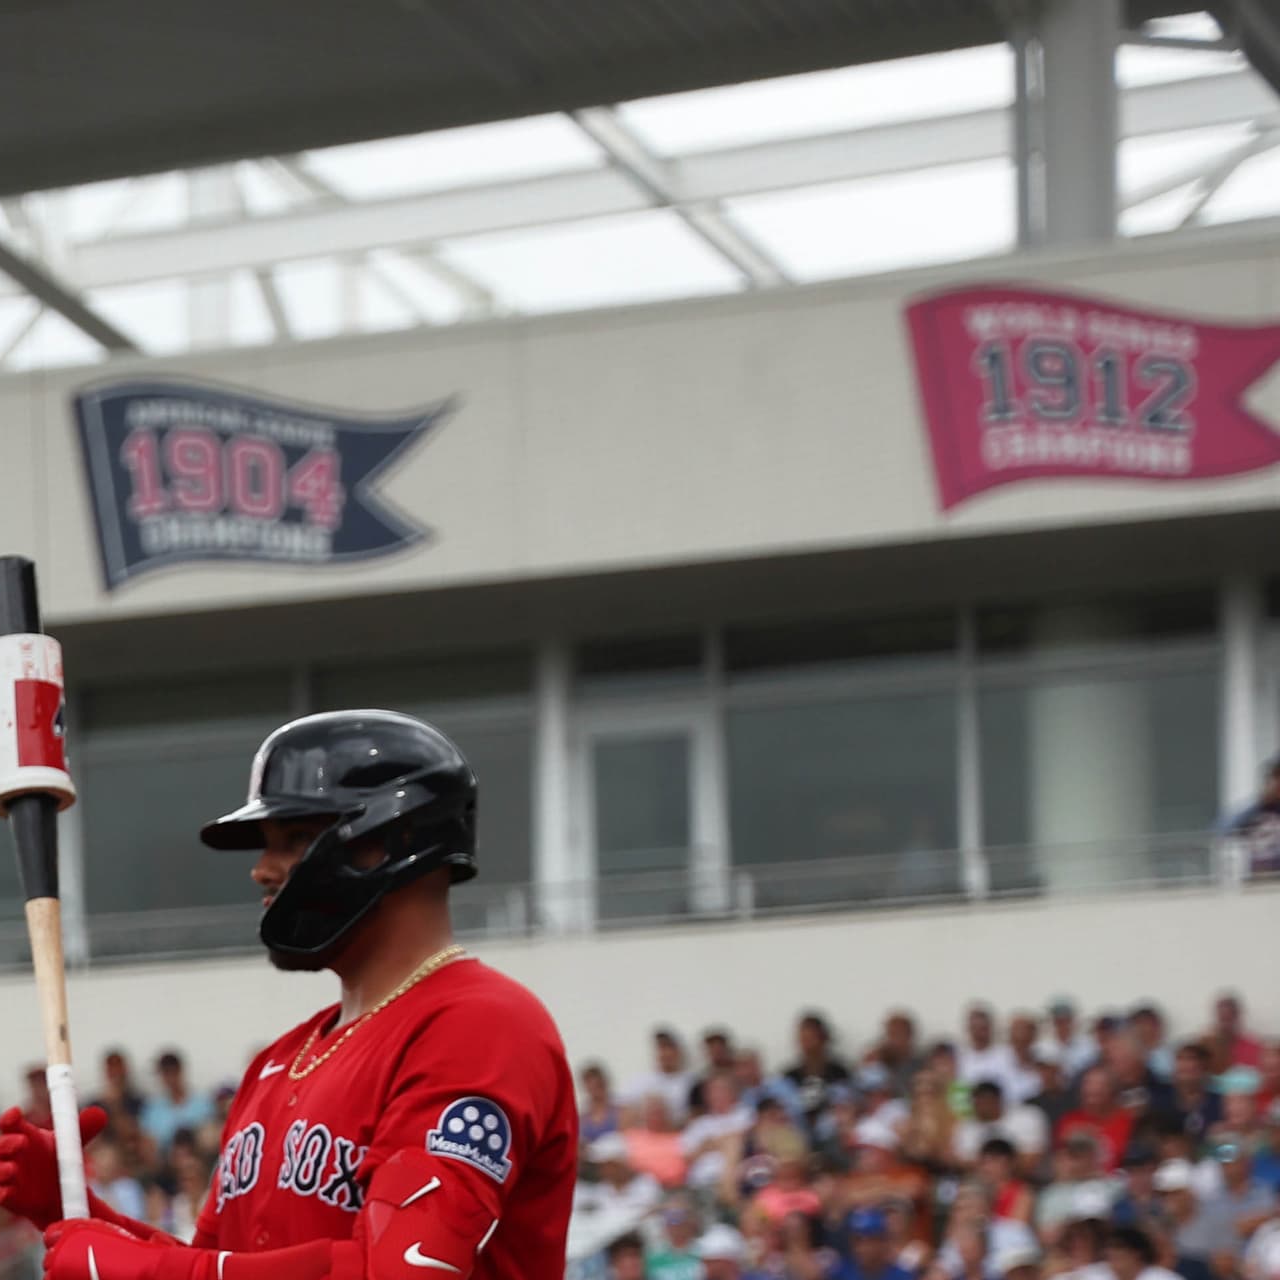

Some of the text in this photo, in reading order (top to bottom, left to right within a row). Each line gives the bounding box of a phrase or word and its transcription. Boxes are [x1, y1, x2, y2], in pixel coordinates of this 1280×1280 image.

[973, 337, 1197, 437] 1912
[121, 426, 344, 528] 1904
[277, 1117, 370, 1212] SOX
[431, 1134, 505, 1176] MassMutual
